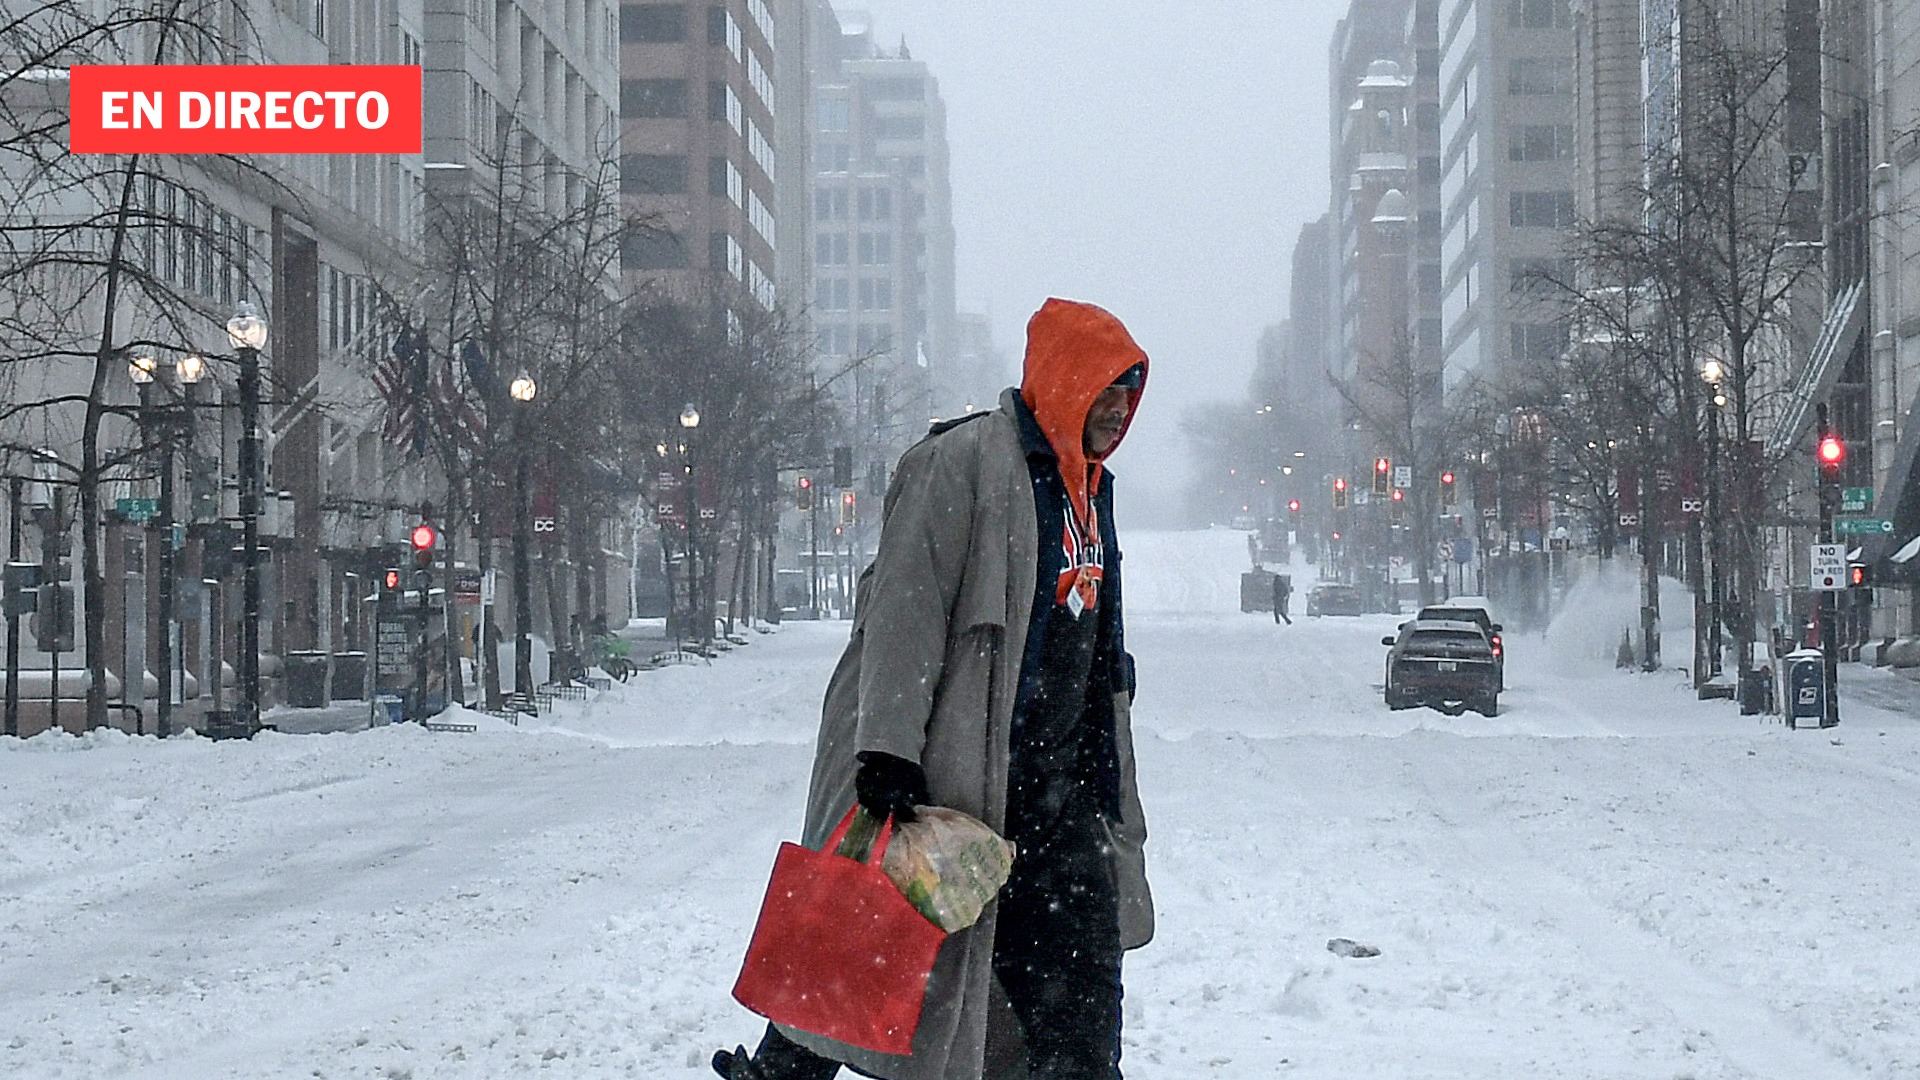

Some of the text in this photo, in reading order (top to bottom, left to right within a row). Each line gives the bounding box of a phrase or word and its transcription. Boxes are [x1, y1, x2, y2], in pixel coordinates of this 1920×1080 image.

[659, 504, 673, 514] DC
[1682, 501, 1702, 512] DC
[700, 509, 715, 518] DC
[1619, 515, 1638, 525] DC
[534, 520, 555, 532] DC
[1819, 547, 1835, 556] NO
[1817, 557, 1839, 566] TURN
[1813, 567, 1844, 575] ON RED
